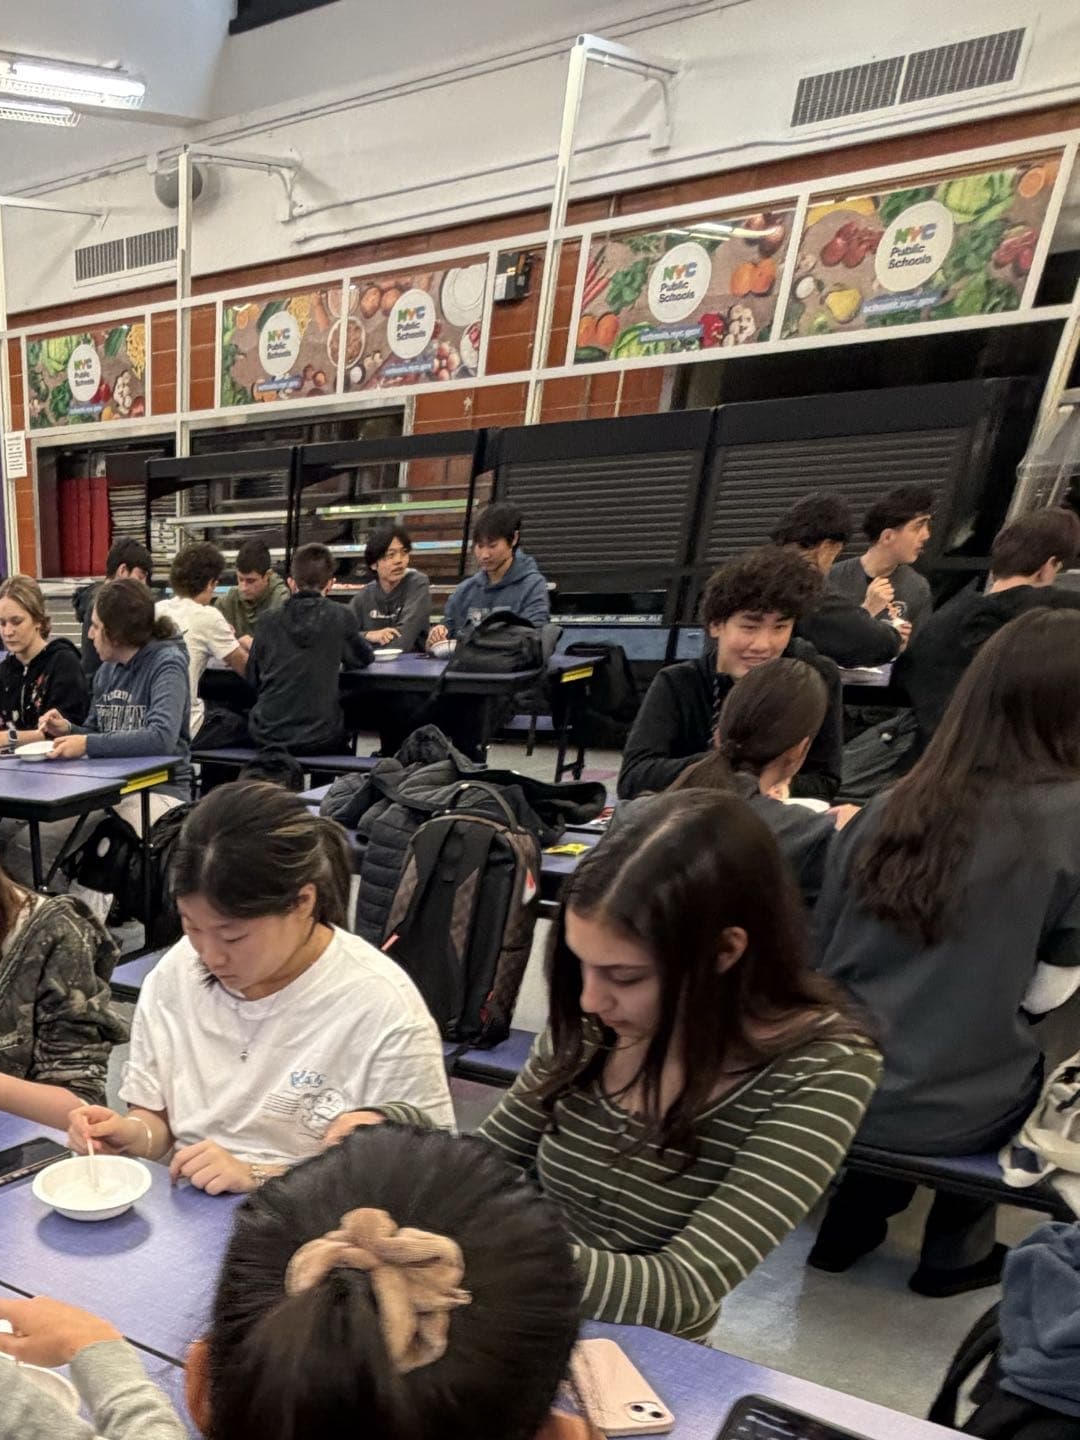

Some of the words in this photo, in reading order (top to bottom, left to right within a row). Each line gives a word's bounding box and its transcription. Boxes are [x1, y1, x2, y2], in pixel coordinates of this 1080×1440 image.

[894, 223, 937, 245] NYC
[890, 244, 926, 257] Public
[888, 254, 932, 269] Schools
[663, 262, 697, 280] NYC
[660, 280, 689, 292] Public
[659, 291, 695, 303] Schools
[398, 306, 426, 322] NYC
[268, 328, 291, 341] NYC
